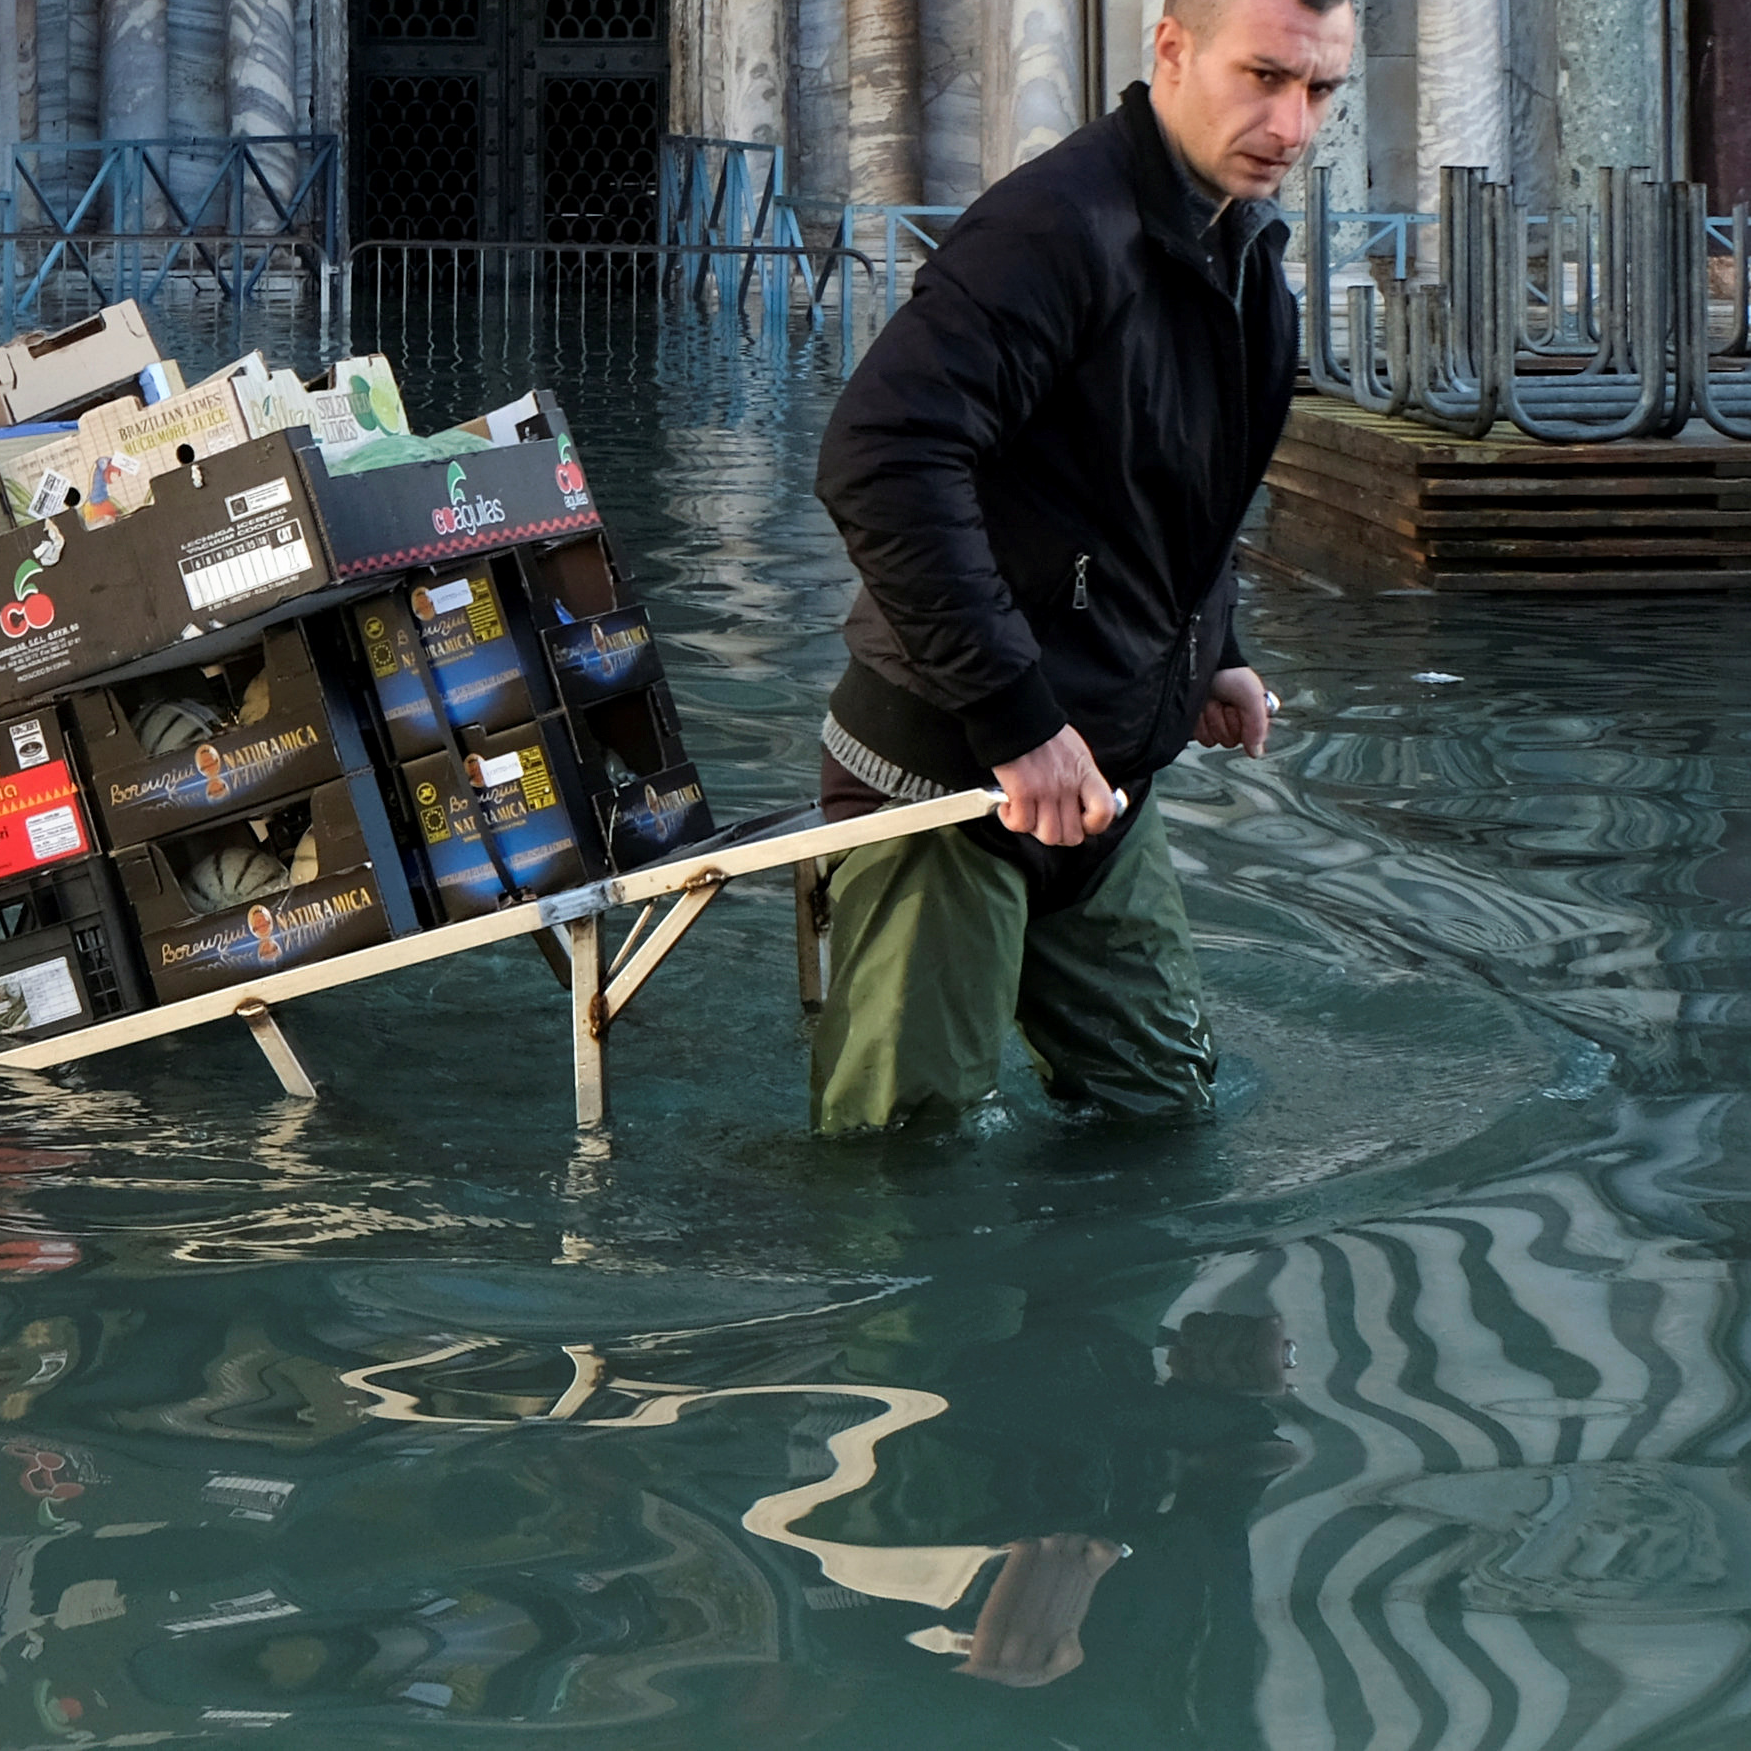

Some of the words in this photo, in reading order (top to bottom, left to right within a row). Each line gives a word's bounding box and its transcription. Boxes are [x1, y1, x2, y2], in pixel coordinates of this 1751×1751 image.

[118, 406, 183, 442] BRAZILIAN
[186, 394, 223, 419] LIMES
[157, 422, 190, 445] MORE
[193, 408, 228, 431] JUICE
[181, 527, 235, 550] LECHUGA
[237, 508, 288, 529] ICEBERG
[186, 533, 235, 554] VACUUM
[237, 516, 285, 536] COOLED
[277, 526, 293, 544] CAT
[223, 725, 318, 770] NATURAMICA
[276, 887, 372, 930] NATURAMICA
